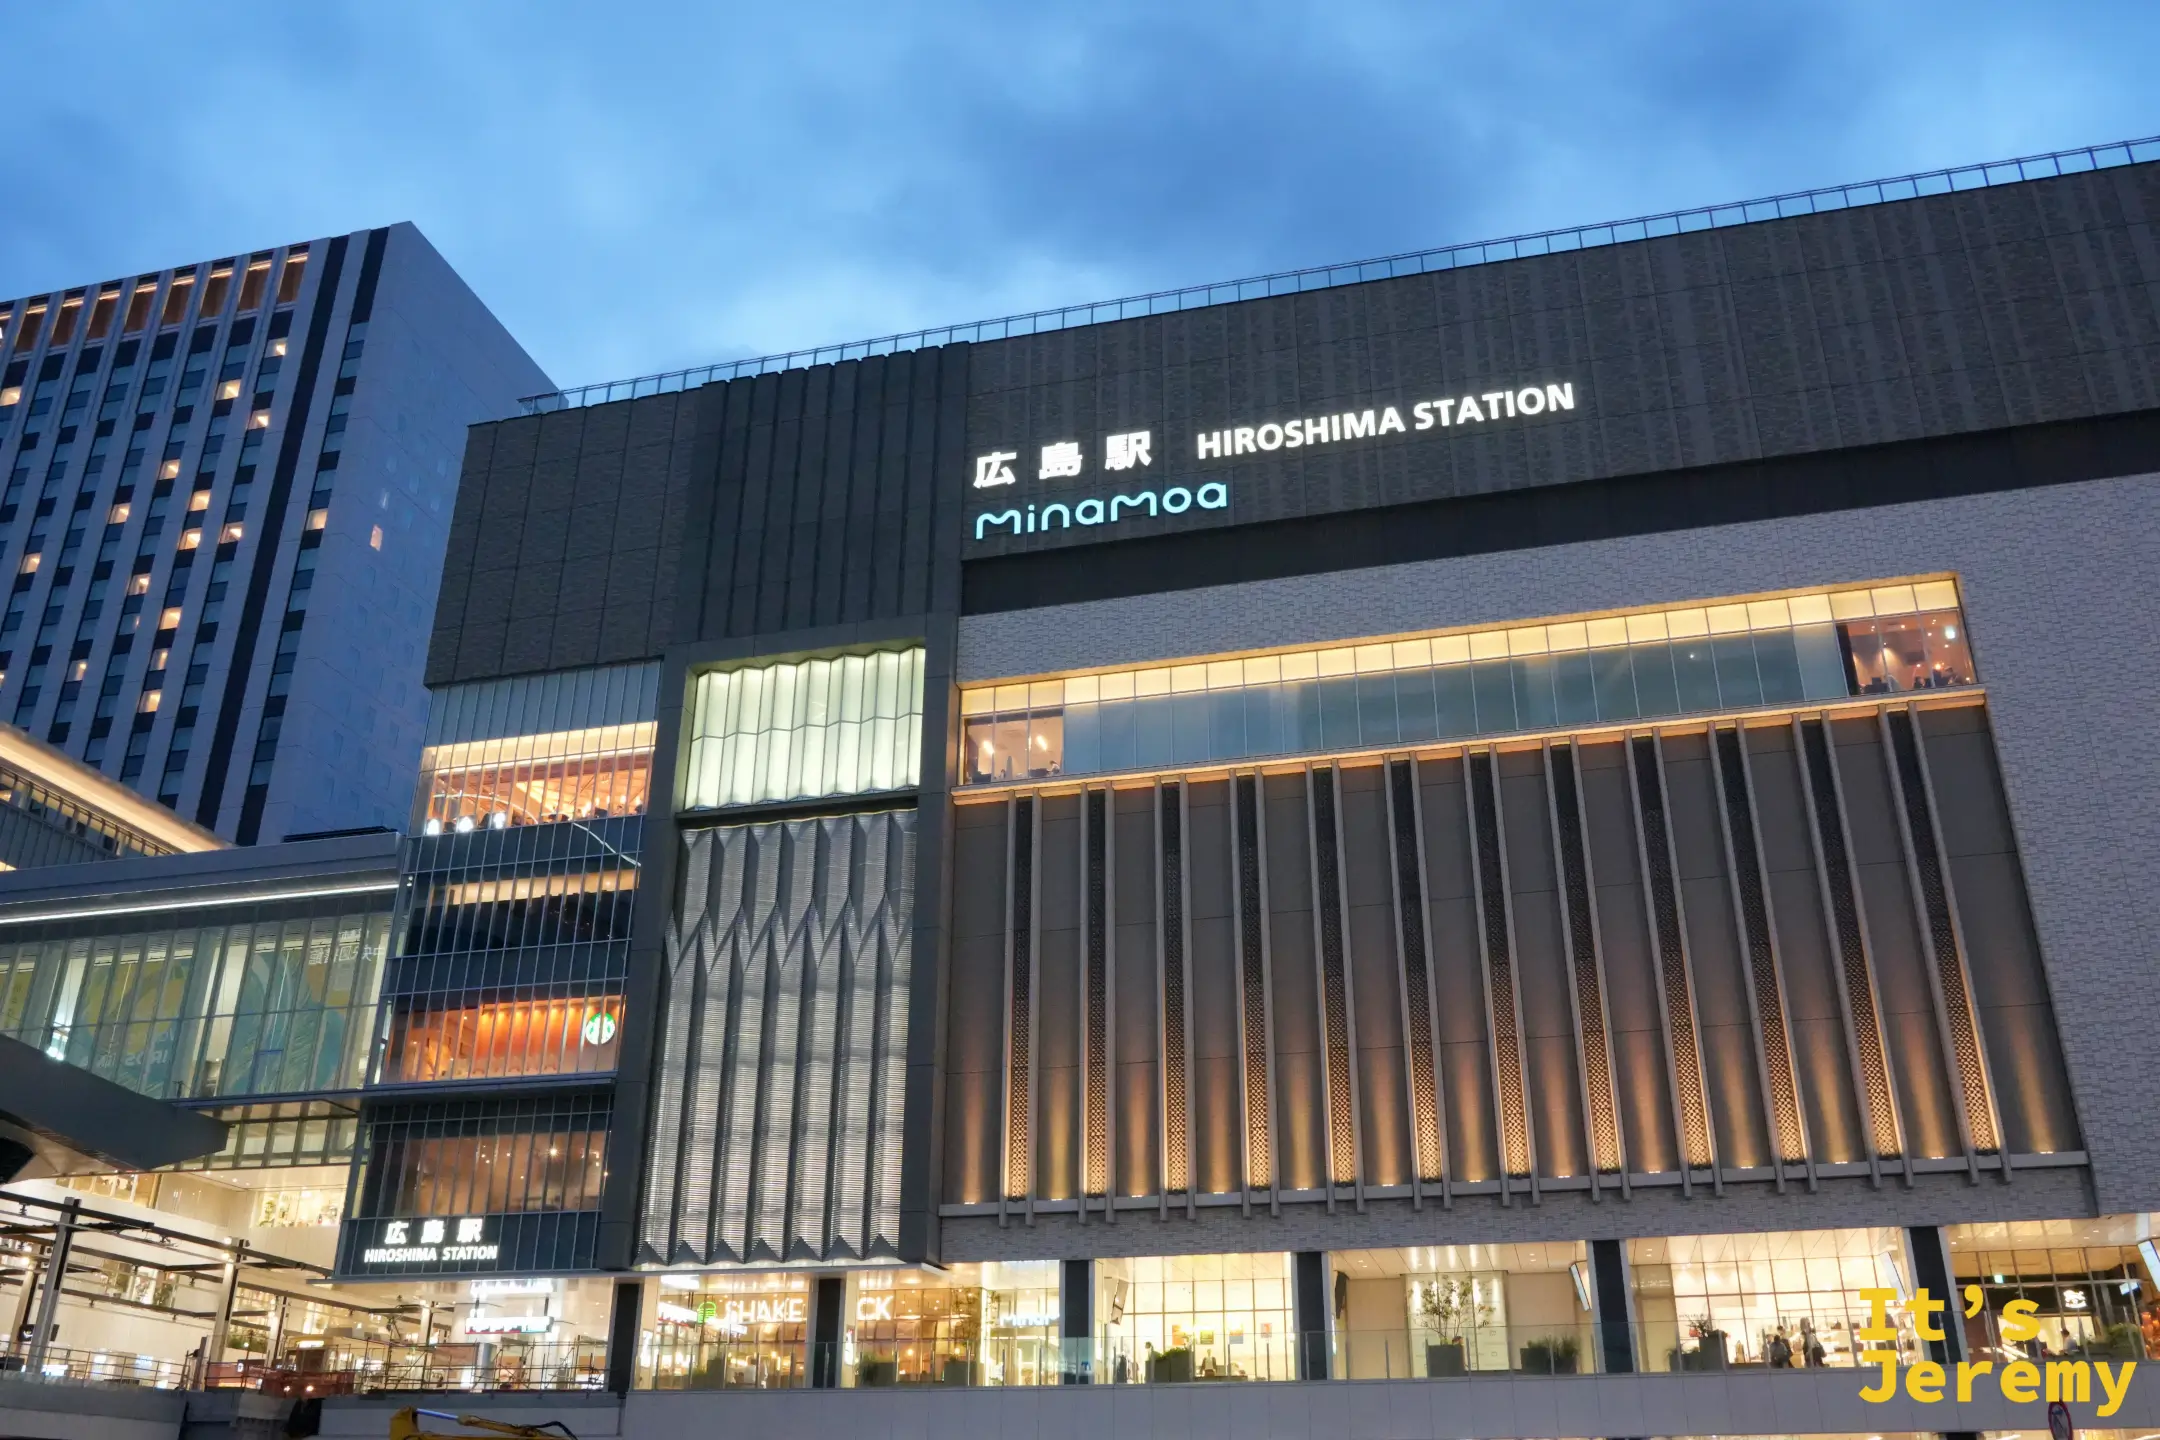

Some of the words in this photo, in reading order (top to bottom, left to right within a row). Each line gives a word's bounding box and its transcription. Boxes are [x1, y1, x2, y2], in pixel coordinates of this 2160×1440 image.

[973, 430, 1155, 489] 広島駅
[1197, 406, 1407, 460] HIROSHIMA
[1413, 382, 1575, 430] STATION
[973, 481, 1228, 540] minamoa
[384, 1217, 484, 1244] 広島駅
[363, 1247, 438, 1263] HIROSHIMA
[441, 1245, 498, 1261] STATION
[723, 1298, 804, 1323] SHAKE
